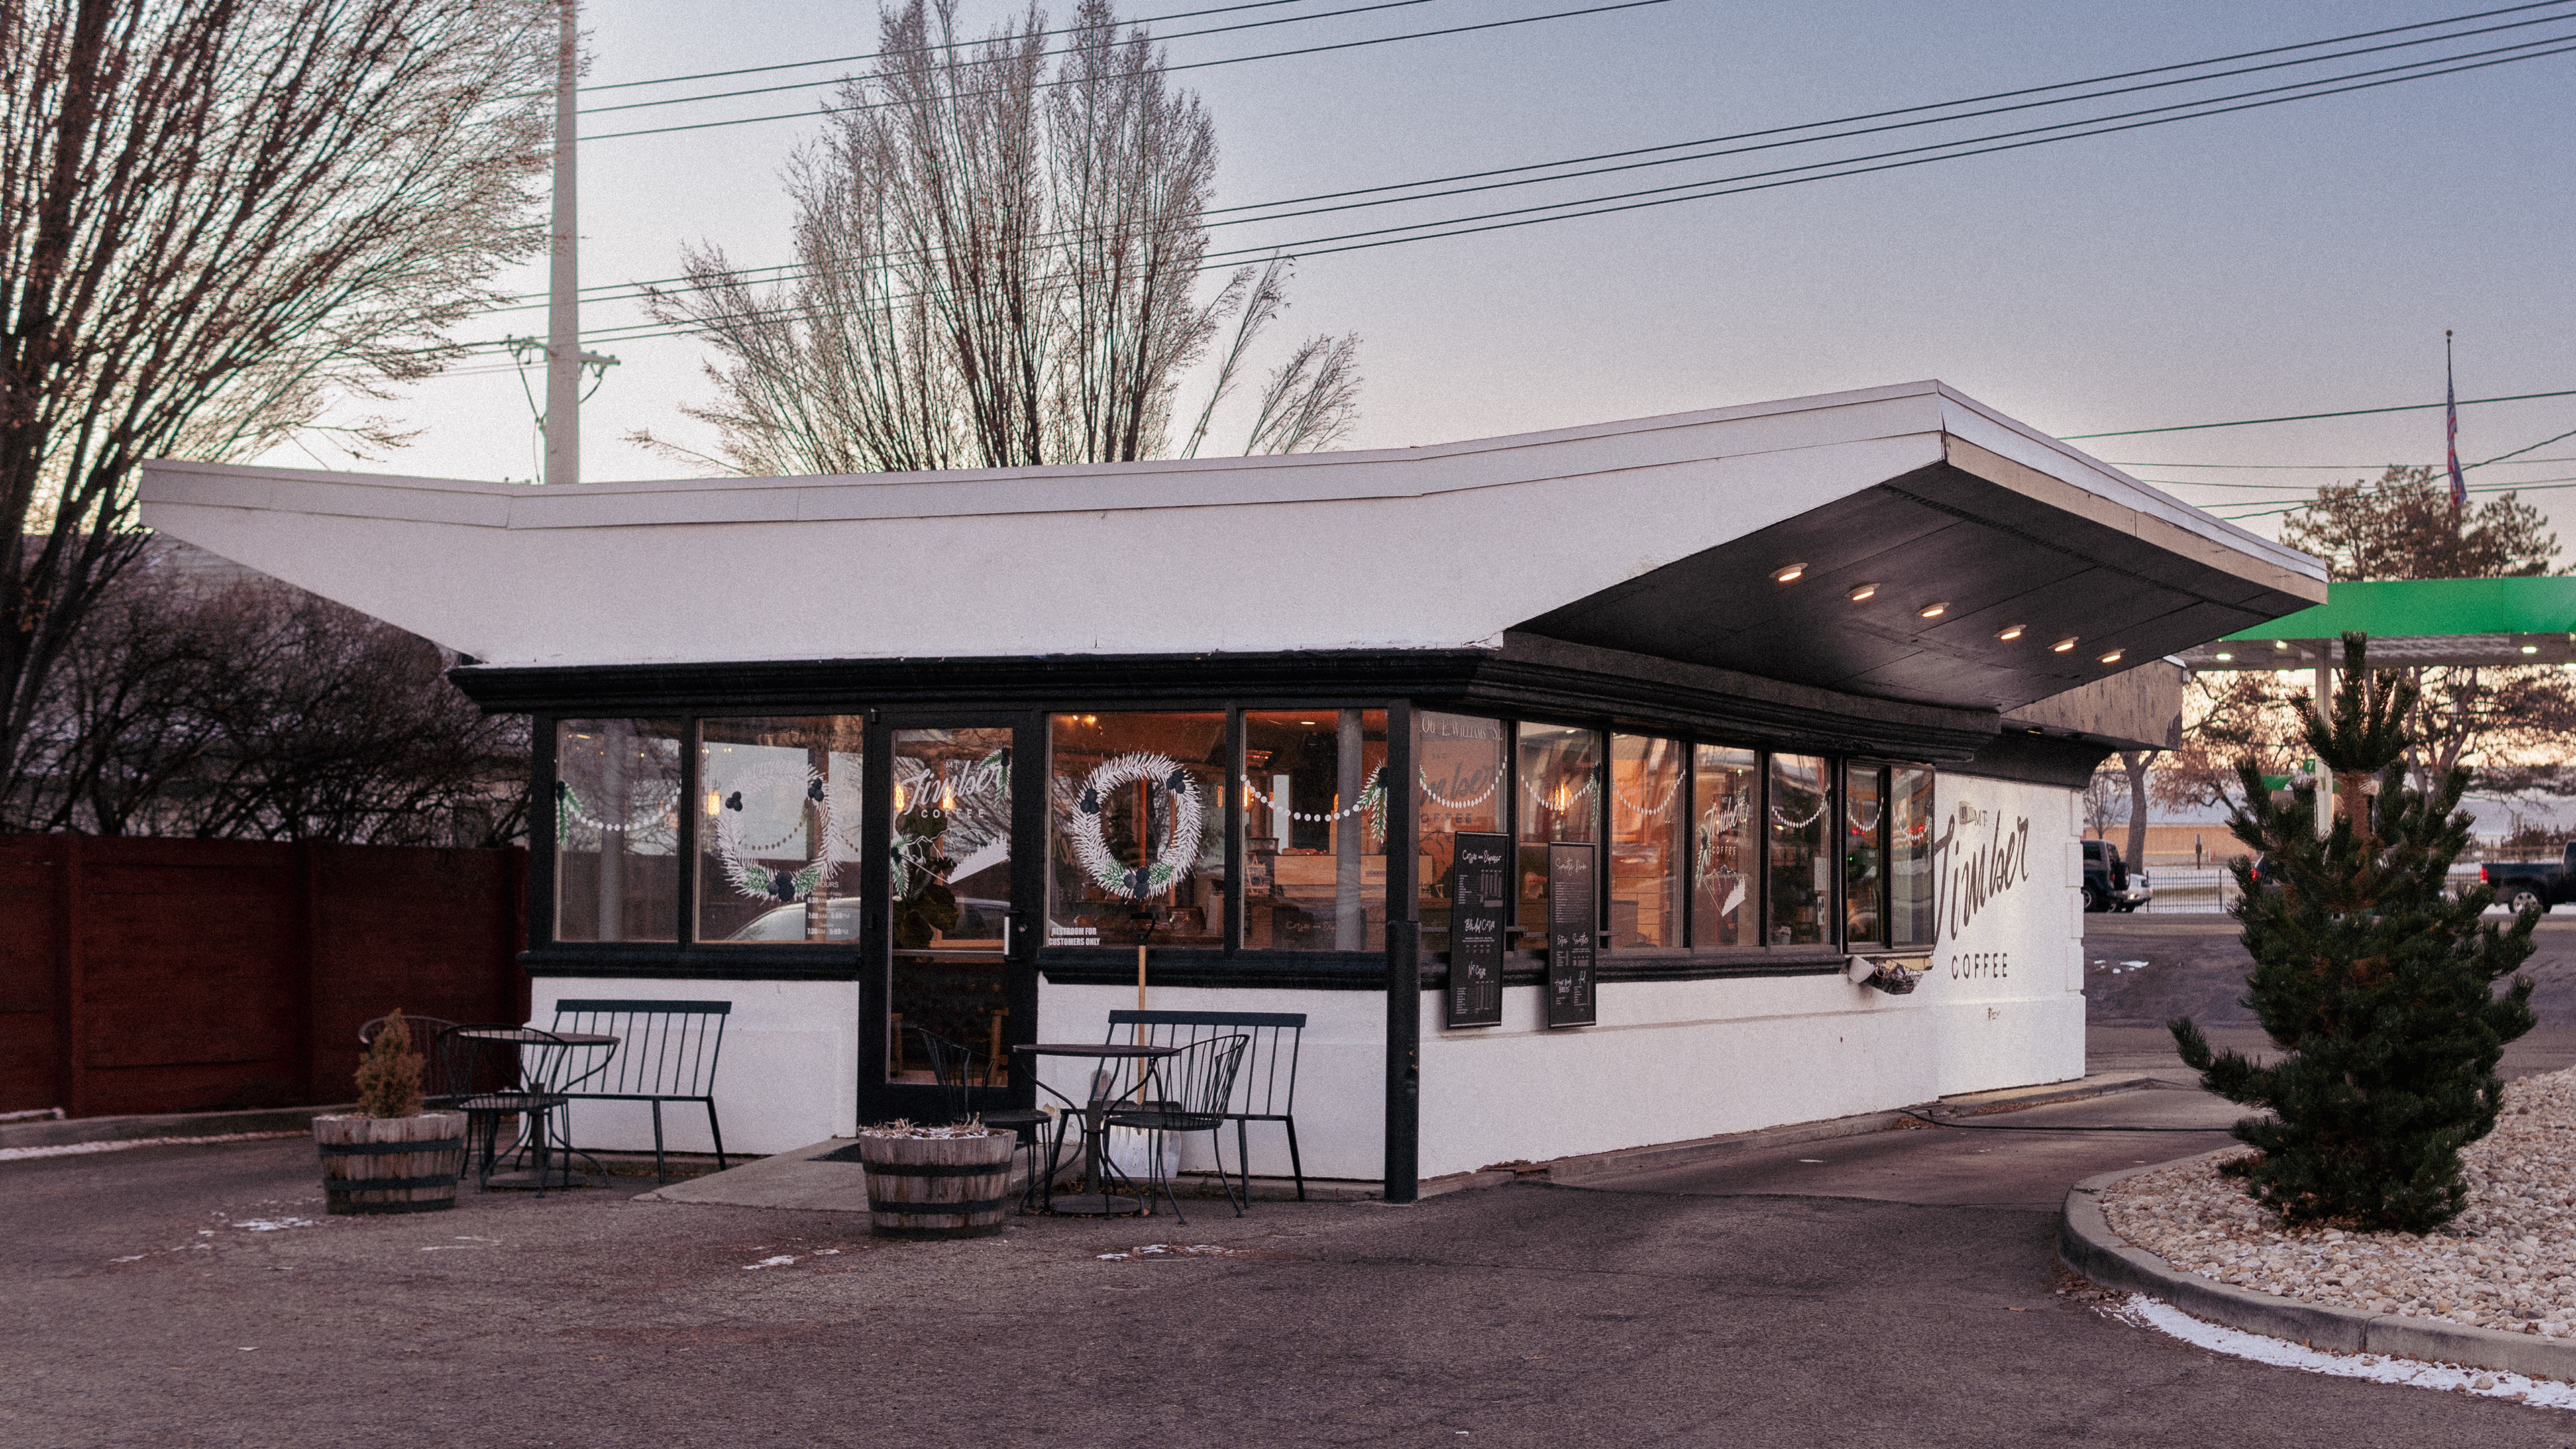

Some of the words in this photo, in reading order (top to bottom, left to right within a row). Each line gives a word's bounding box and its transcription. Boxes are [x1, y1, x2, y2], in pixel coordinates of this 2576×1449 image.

[1419, 716, 1436, 733] 06
[2308, 761, 2314, 770] 7
[900, 760, 1002, 816] Timber
[1419, 763, 1497, 807] mber
[921, 809, 984, 818] COFFEE
[1419, 812, 1472, 824] OFFEE
[1705, 796, 1746, 843] Timber
[1974, 810, 1987, 826] MT
[1712, 847, 1736, 855] COFFEE
[1934, 808, 2029, 950] Timber
[1951, 953, 2008, 980] COFFEE
